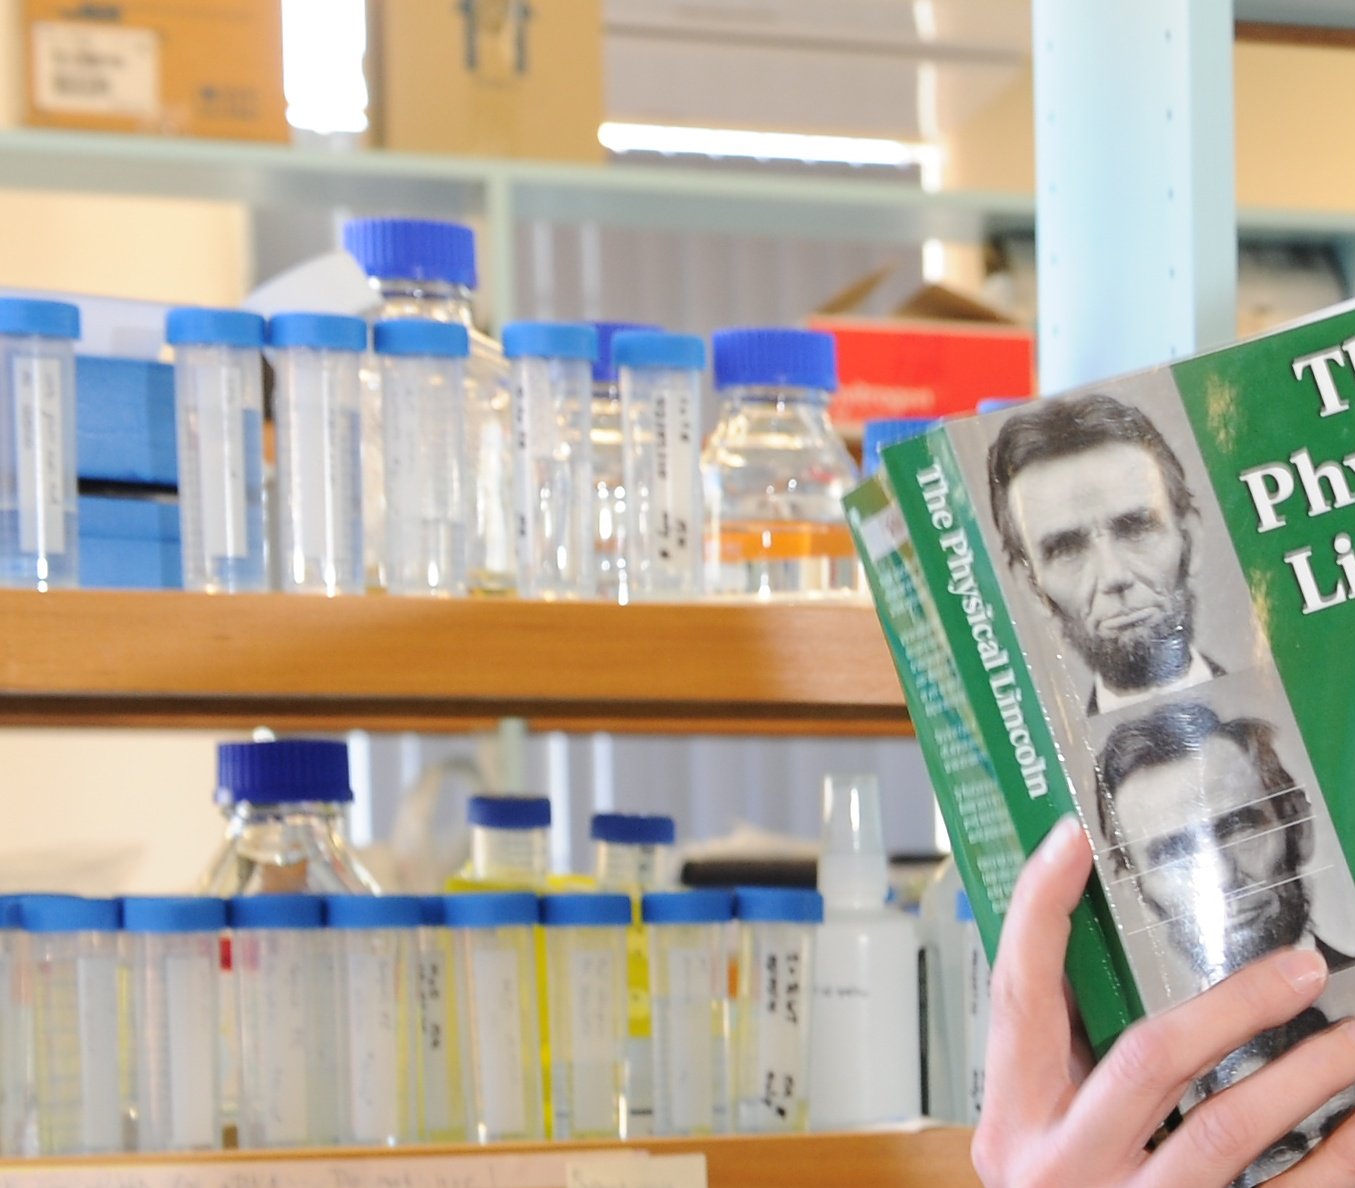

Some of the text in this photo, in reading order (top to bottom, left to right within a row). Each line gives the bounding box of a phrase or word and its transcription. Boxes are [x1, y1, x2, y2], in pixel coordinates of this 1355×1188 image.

[917, 463, 953, 530] The
[939, 528, 1009, 672] Physical
[988, 670, 1048, 800] Lincoln
